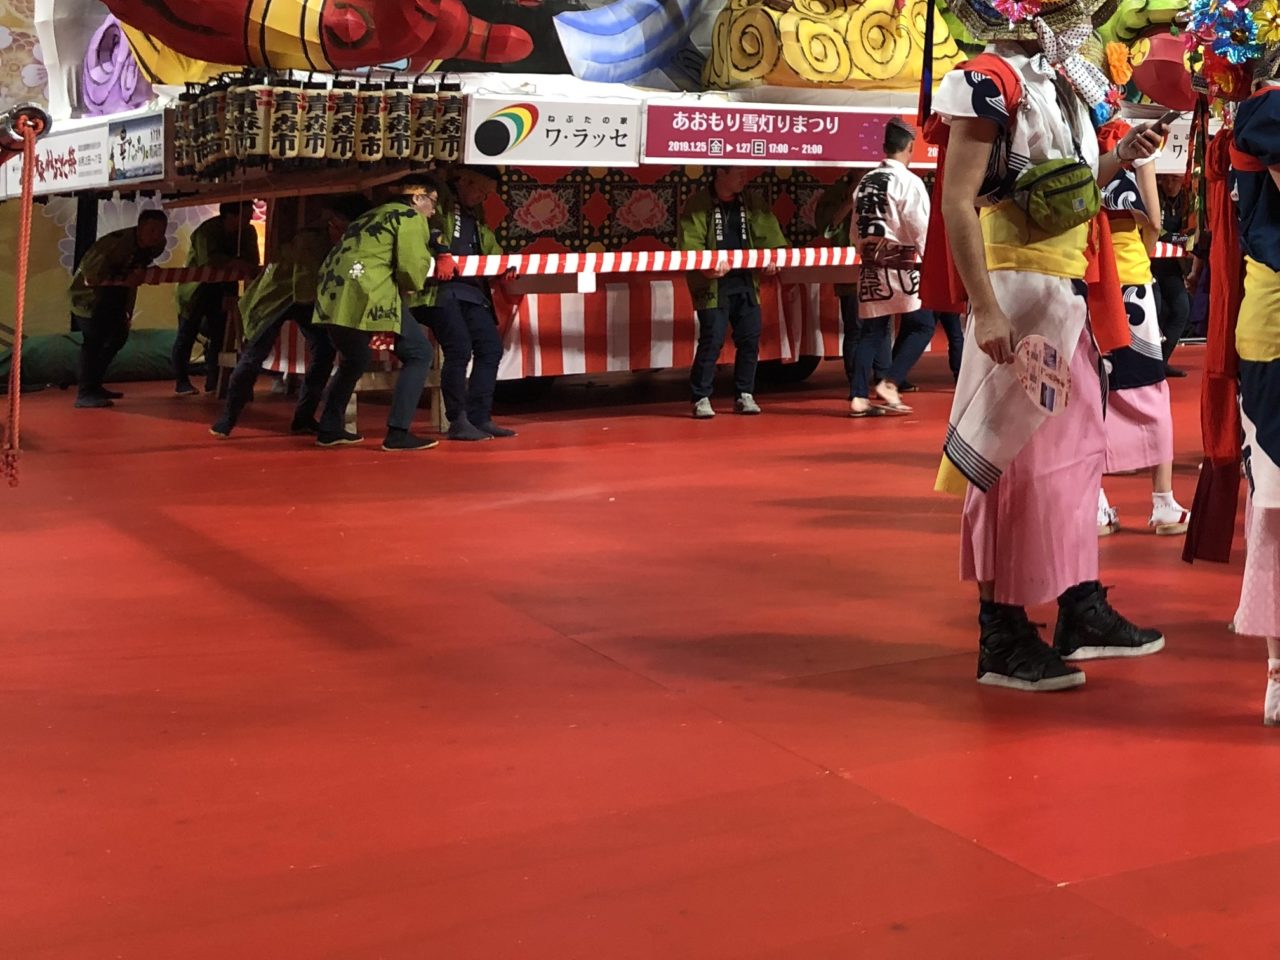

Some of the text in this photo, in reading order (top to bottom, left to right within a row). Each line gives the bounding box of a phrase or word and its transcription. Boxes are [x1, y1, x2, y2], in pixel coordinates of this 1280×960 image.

[547, 115, 628, 125] ねぶたの家
[672, 111, 839, 135] あおもり雪灯りまつり
